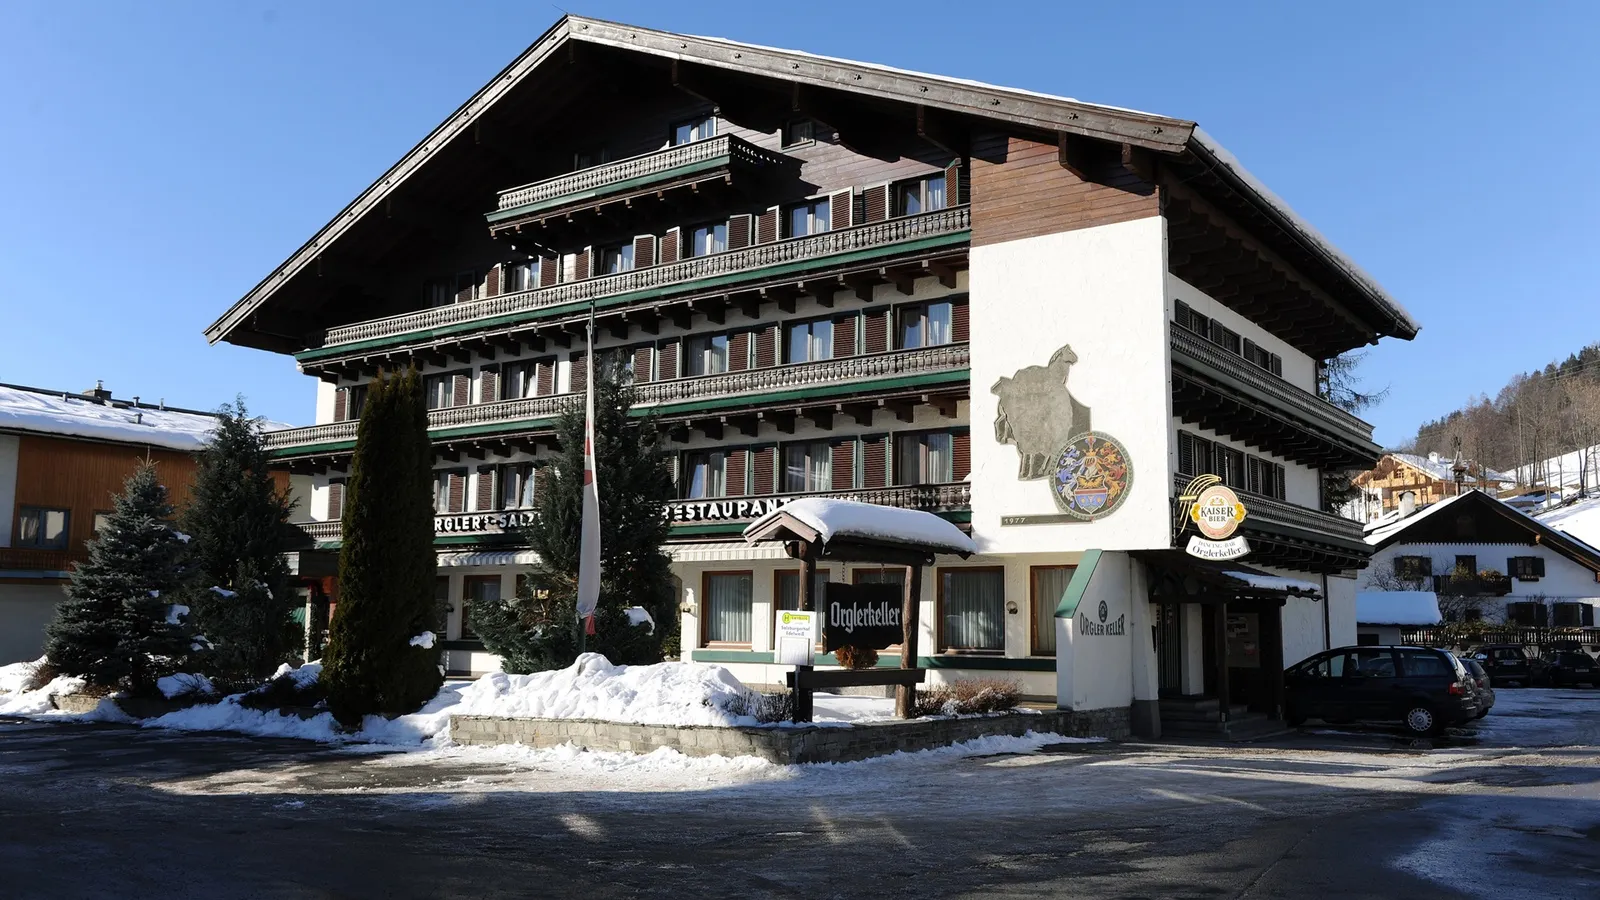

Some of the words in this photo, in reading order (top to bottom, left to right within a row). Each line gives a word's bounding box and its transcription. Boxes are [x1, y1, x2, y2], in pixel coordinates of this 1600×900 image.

[1200, 507, 1234, 518] KAISER
[1003, 517, 1026, 525] 1977
[1192, 545, 1242, 558] Orglerkeller
[830, 601, 900, 634] Orglerkeller
[1080, 612, 1105, 636] ORGLER
[1105, 613, 1125, 636] KELLER
